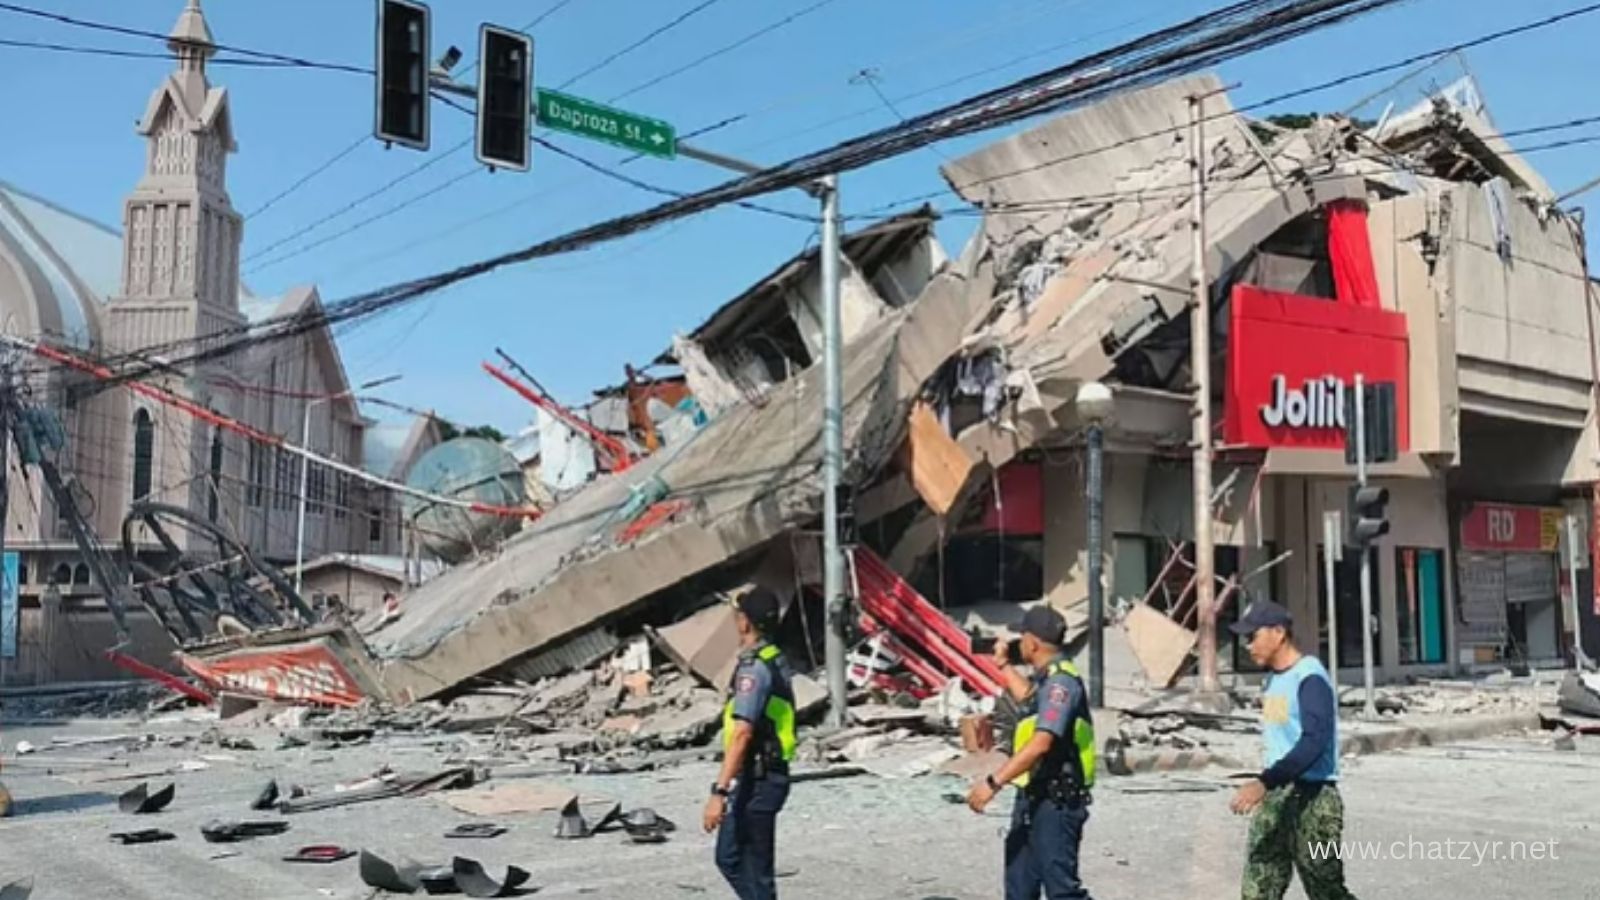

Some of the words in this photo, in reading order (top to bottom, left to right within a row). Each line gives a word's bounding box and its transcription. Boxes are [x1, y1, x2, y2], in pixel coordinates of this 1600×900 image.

[549, 101, 618, 134] Daproza
[624, 124, 645, 142] St.
[1487, 509, 1516, 542] RD
